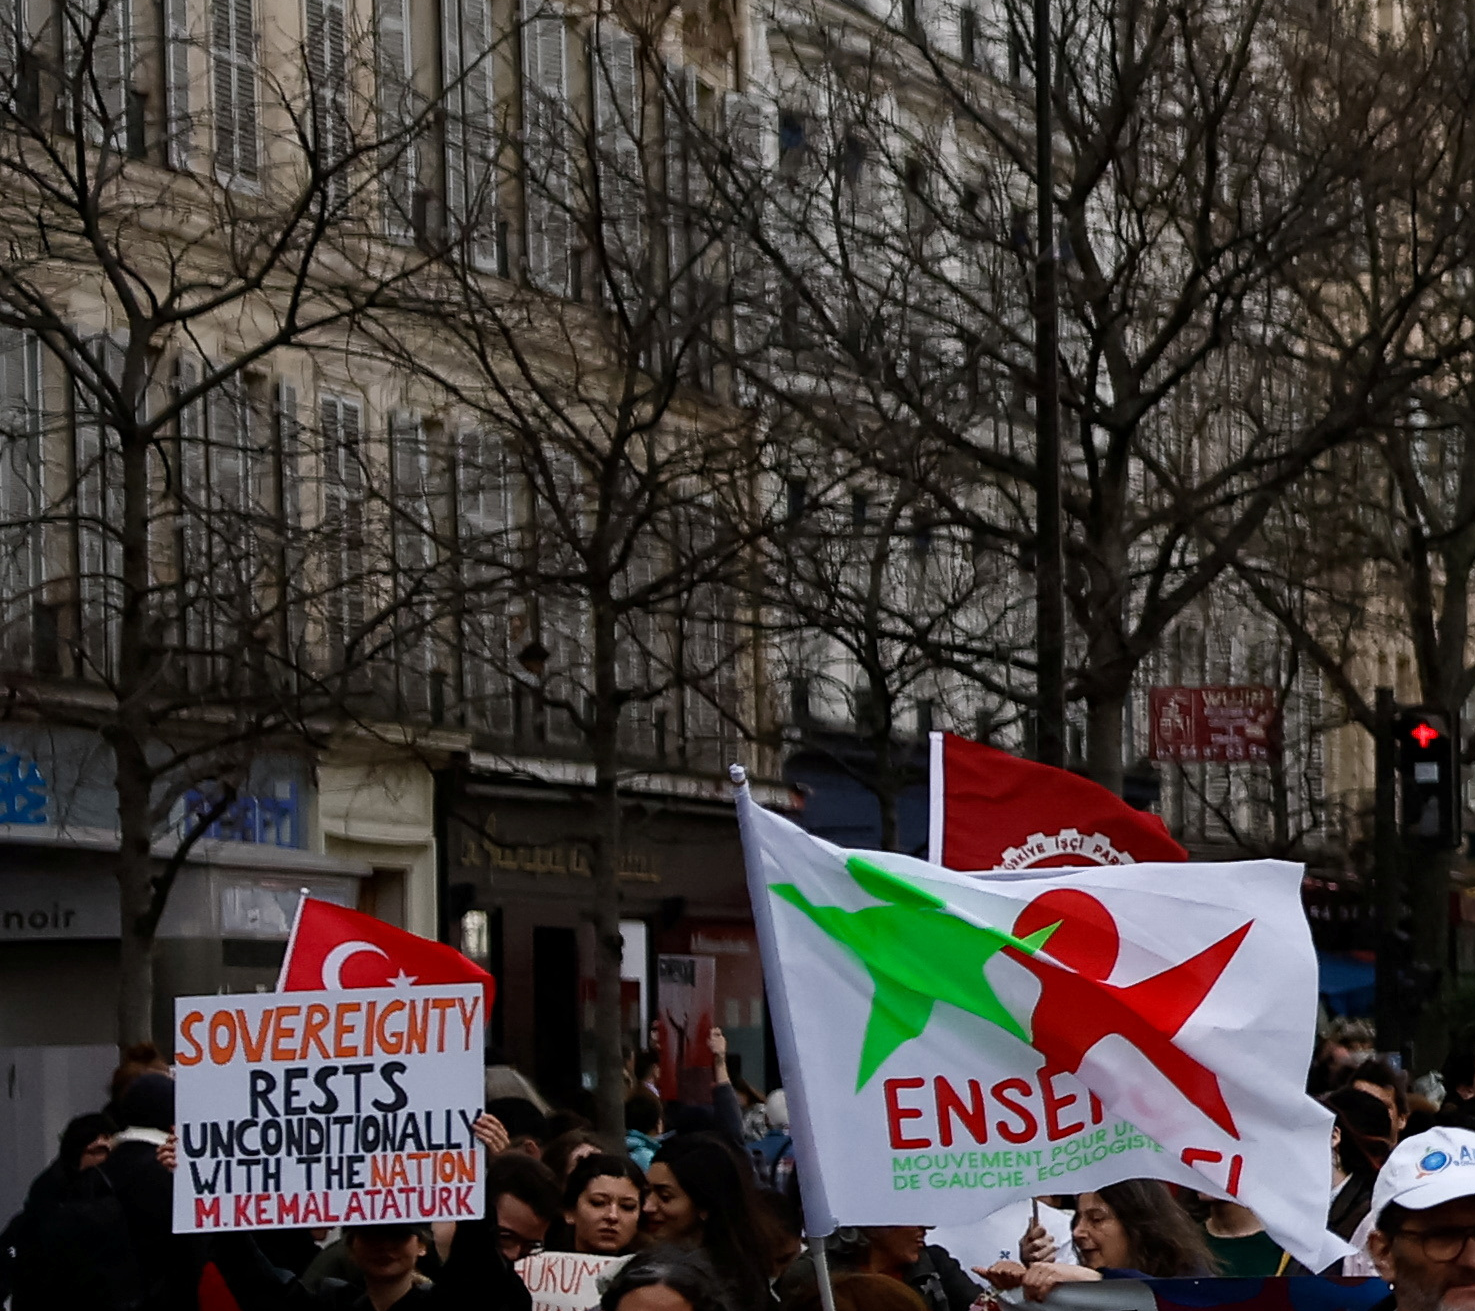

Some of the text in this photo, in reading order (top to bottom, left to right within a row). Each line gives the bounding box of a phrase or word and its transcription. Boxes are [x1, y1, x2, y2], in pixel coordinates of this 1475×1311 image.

[1093, 843, 1125, 866] PAR
[4, 901, 76, 931] noir
[174, 996, 480, 1066] SOVEREIGNTY
[250, 1061, 408, 1118] RESTS
[884, 1066, 1104, 1151] ENSE
[182, 1108, 483, 1158] UNCONDITIONALLY
[892, 1149, 1043, 1173] MOUVEMENT
[1051, 1129, 1107, 1162] POUR
[189, 1149, 477, 1195] WITH THE NATION
[893, 1174, 920, 1190] DE
[343, 1185, 476, 1222] ATATURK
